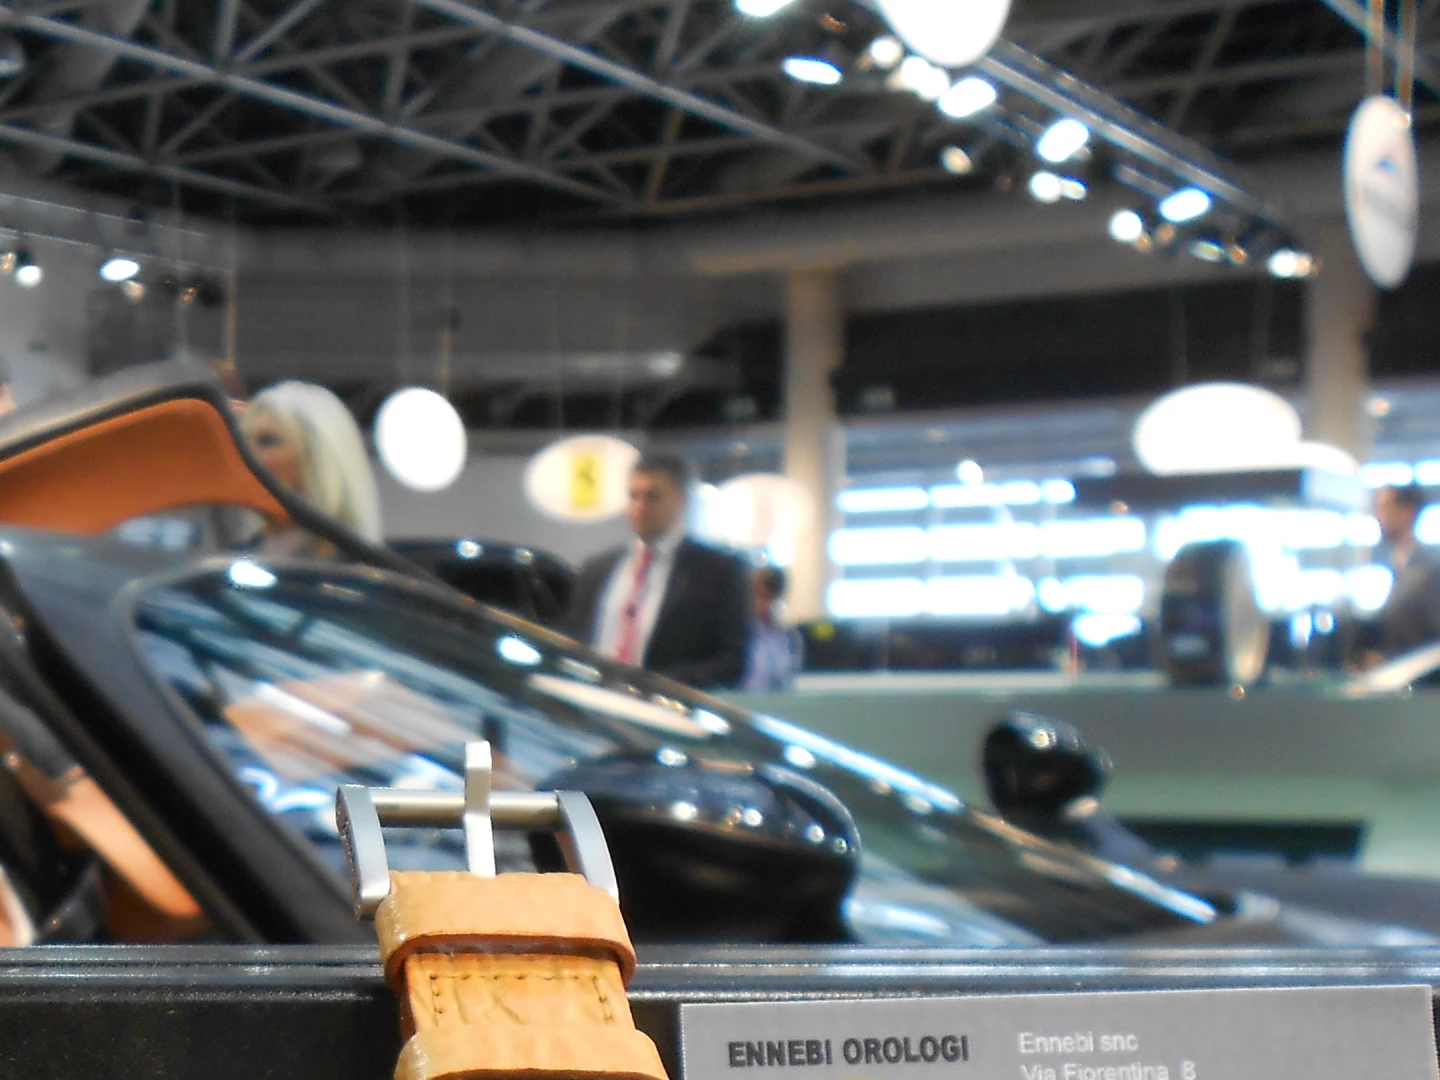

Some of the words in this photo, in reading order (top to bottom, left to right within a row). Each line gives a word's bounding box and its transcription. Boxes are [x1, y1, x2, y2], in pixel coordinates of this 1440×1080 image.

[728, 1039, 834, 1067] ENNEBI
[843, 1034, 970, 1065] OROLOGI
[1018, 1031, 1094, 1054] Ennebi
[1100, 1034, 1139, 1052] snc
[1181, 1060, 1197, 1080] 8
